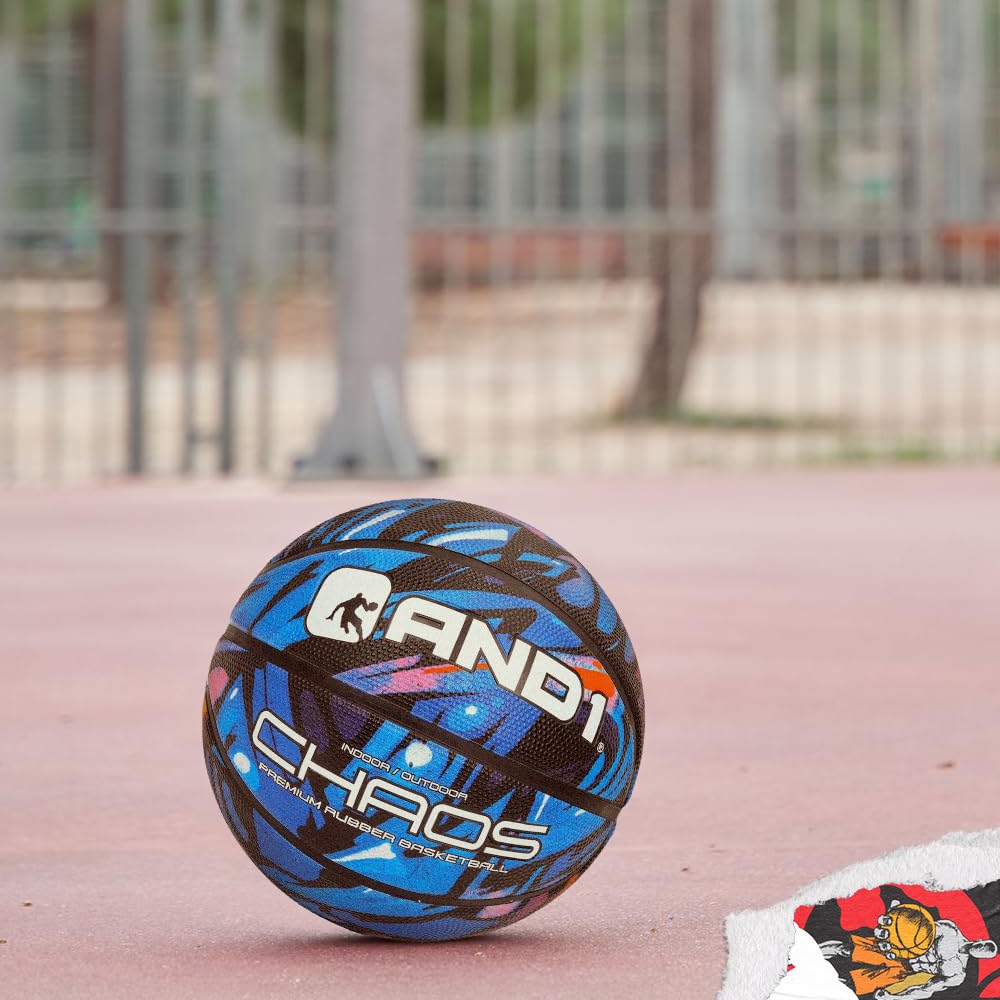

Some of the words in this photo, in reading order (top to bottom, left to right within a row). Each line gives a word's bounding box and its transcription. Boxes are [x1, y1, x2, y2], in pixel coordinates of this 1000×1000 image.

[252, 710, 549, 860] CHAOS
[258, 762, 322, 810] PREMIUM
[324, 807, 396, 843] RUBBER
[398, 838, 509, 874] BASKETBALL
[341, 742, 391, 772] INDOOR
[400, 771, 468, 801] OUTDOOR
